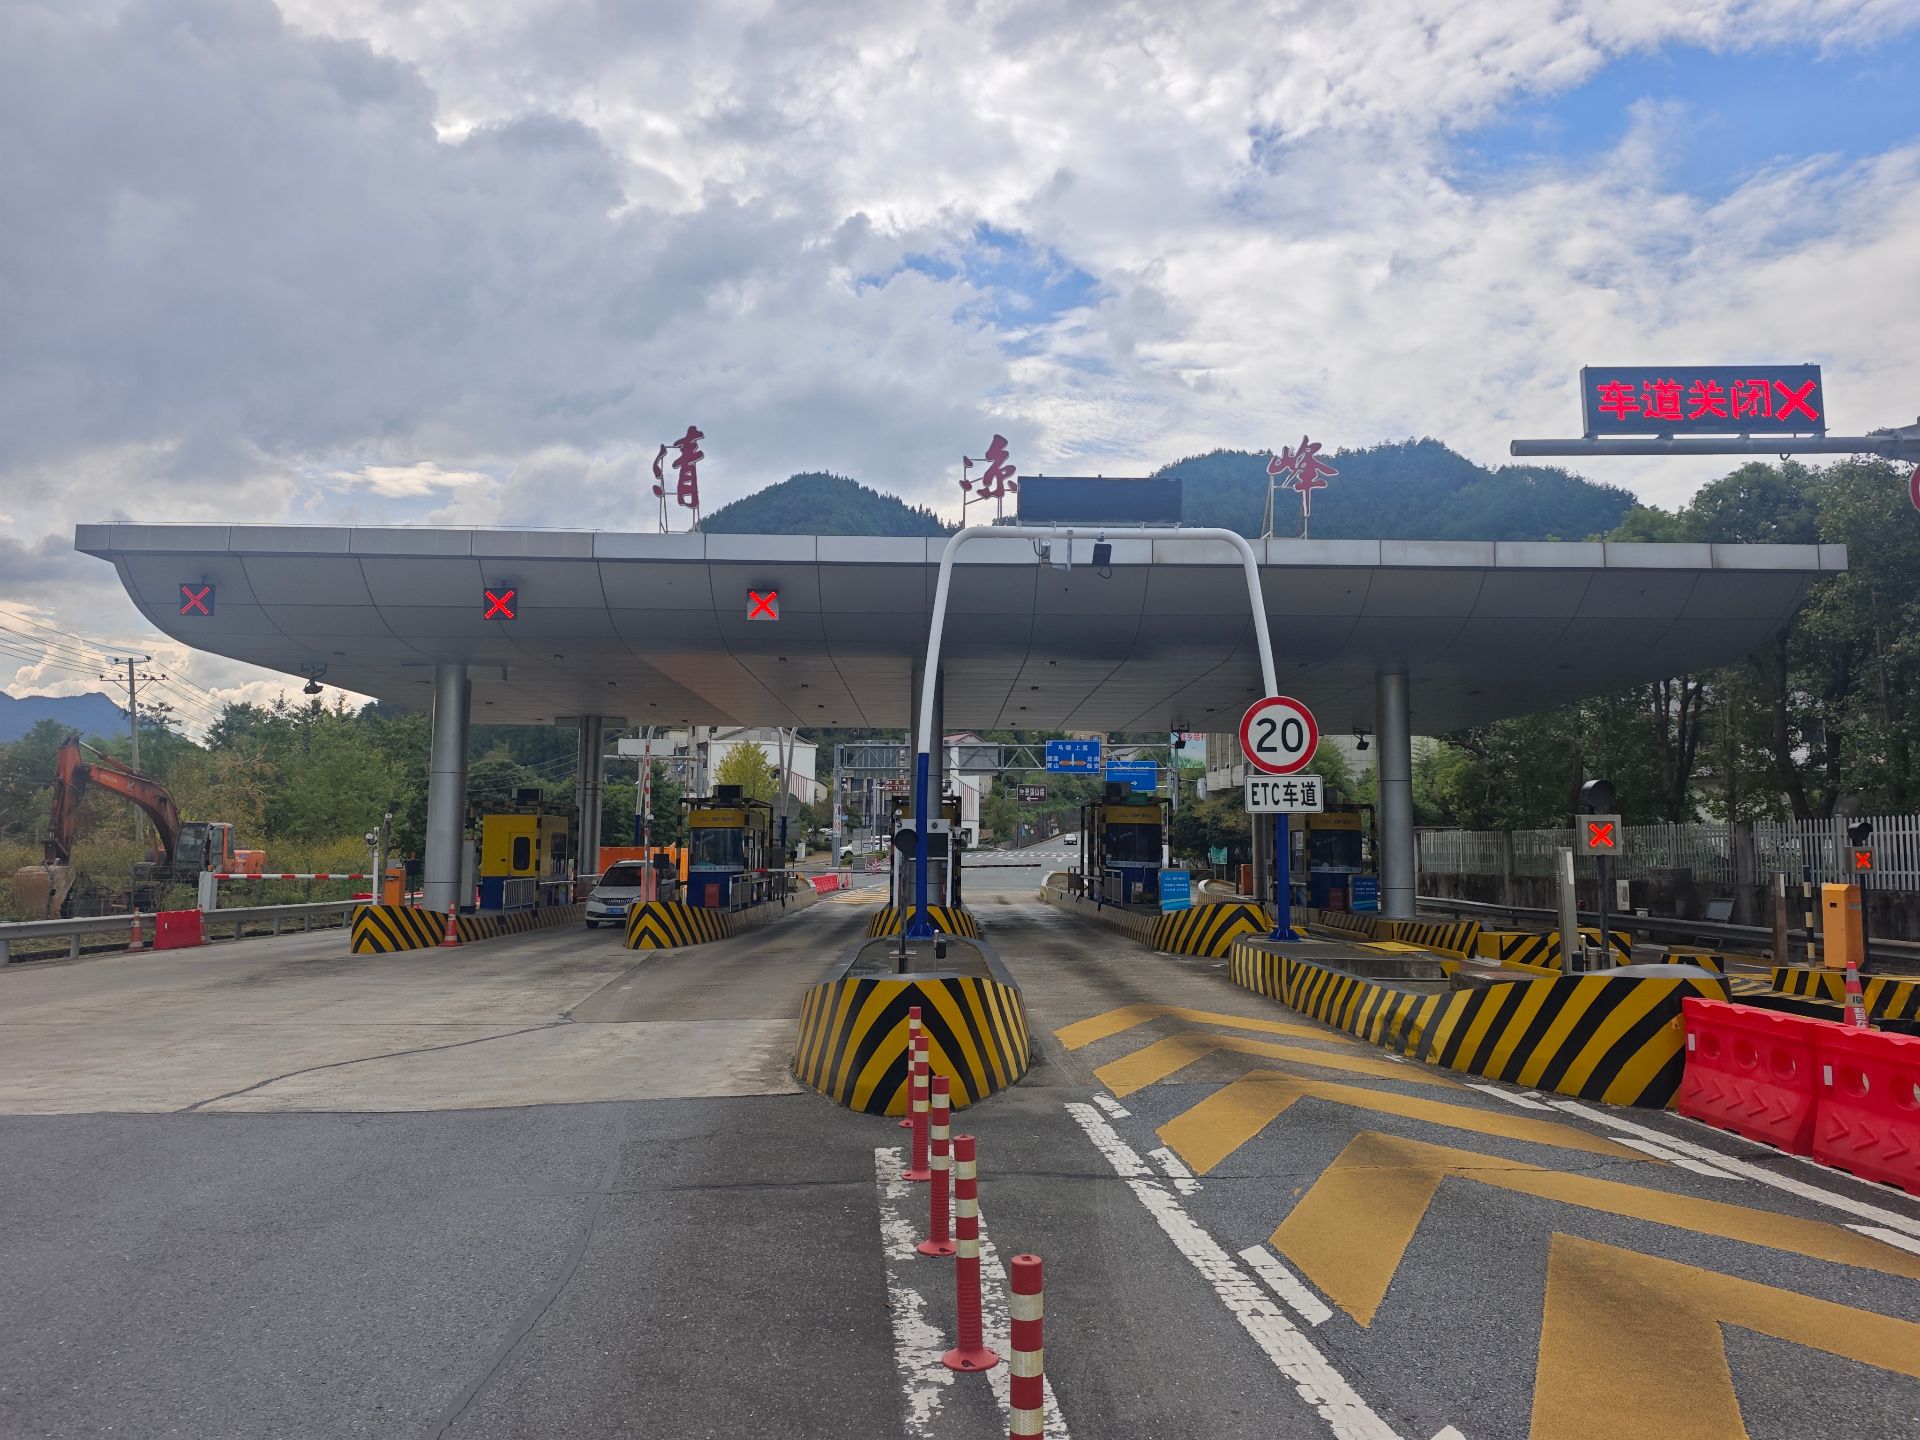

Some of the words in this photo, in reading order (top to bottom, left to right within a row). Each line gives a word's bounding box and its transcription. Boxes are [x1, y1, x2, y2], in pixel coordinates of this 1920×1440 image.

[1597, 378, 1772, 420] 车道关闭
[1256, 718, 1304, 753] 20
[1251, 781, 1318, 808] ETC车道
